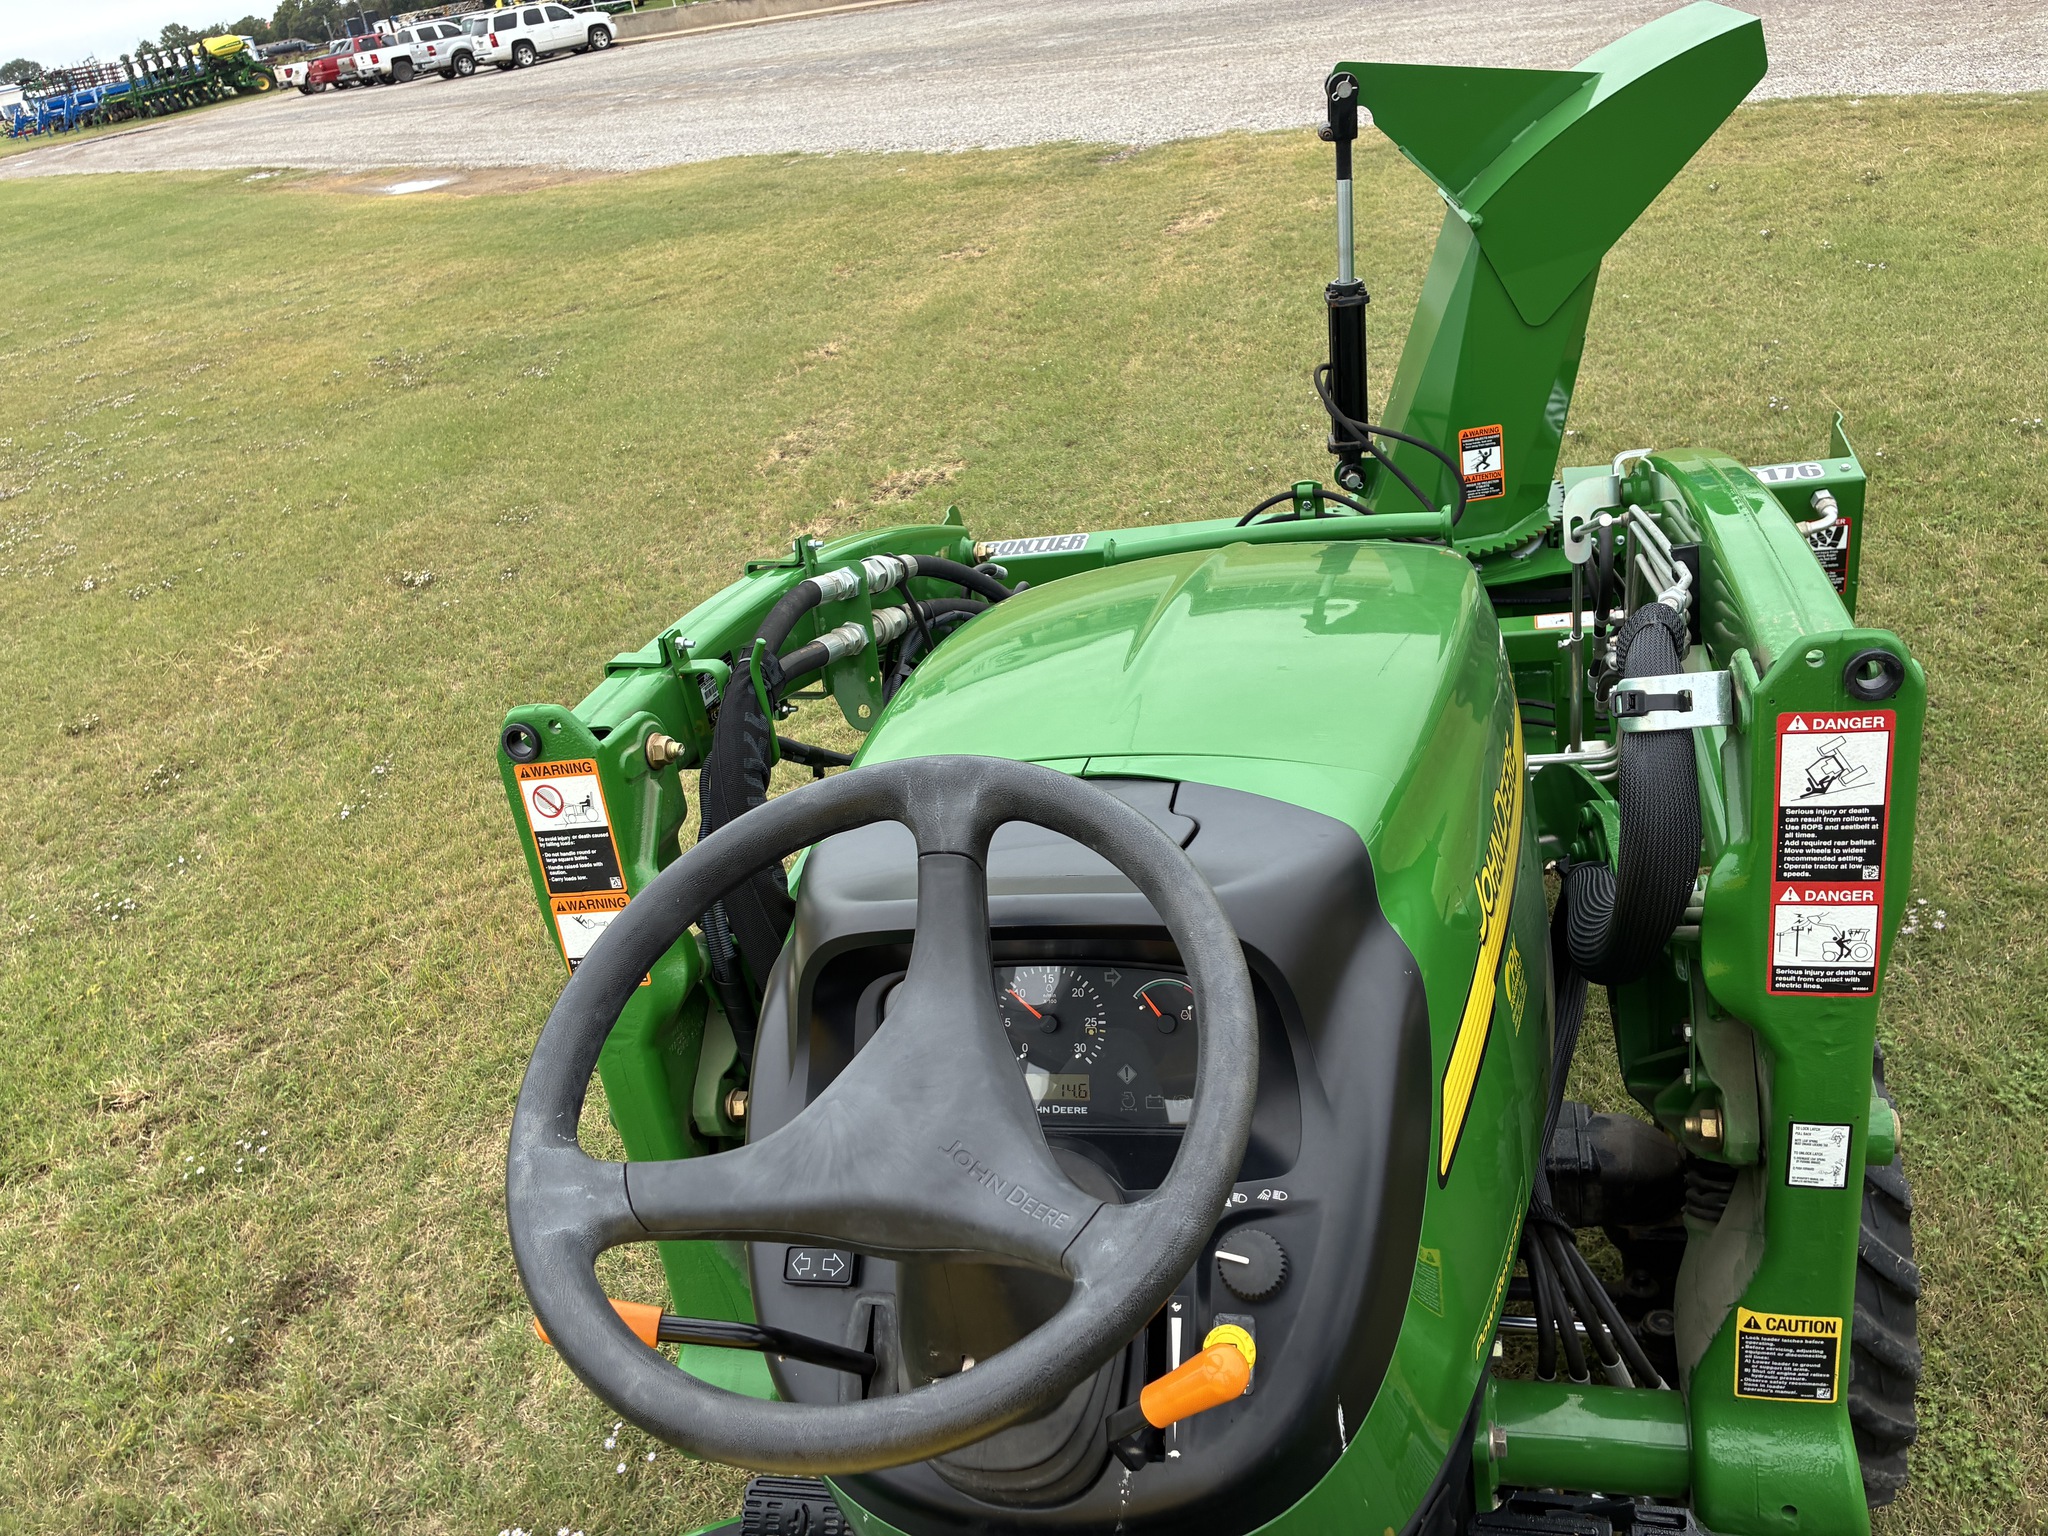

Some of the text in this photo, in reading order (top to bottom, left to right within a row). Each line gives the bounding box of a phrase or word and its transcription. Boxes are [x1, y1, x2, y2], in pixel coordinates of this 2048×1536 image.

[1469, 426, 1499, 436] WARNING
[1471, 471, 1501, 481] ATTENTION
[1752, 464, 1821, 480] 176
[1813, 716, 1884, 730] DANGER
[530, 762, 592, 777] WARNING
[1474, 728, 1516, 946] JOHN DEERE
[1805, 890, 1873, 901] DANGER
[566, 897, 626, 911] WARNING
[1043, 974, 1054, 983] 15
[1014, 989, 1026, 997] 10
[1072, 988, 1084, 997] 20
[1004, 1018, 1011, 1027] 5
[1085, 1018, 1097, 1026] 25
[1022, 1043, 1028, 1052] 0
[1074, 1043, 1086, 1052] 30
[1062, 1084, 1087, 1098] 14.6
[1053, 1105, 1088, 1114] DEERE
[938, 1140, 1070, 1229] JOHN DEERE
[1766, 1318, 1836, 1334] CAUTION
